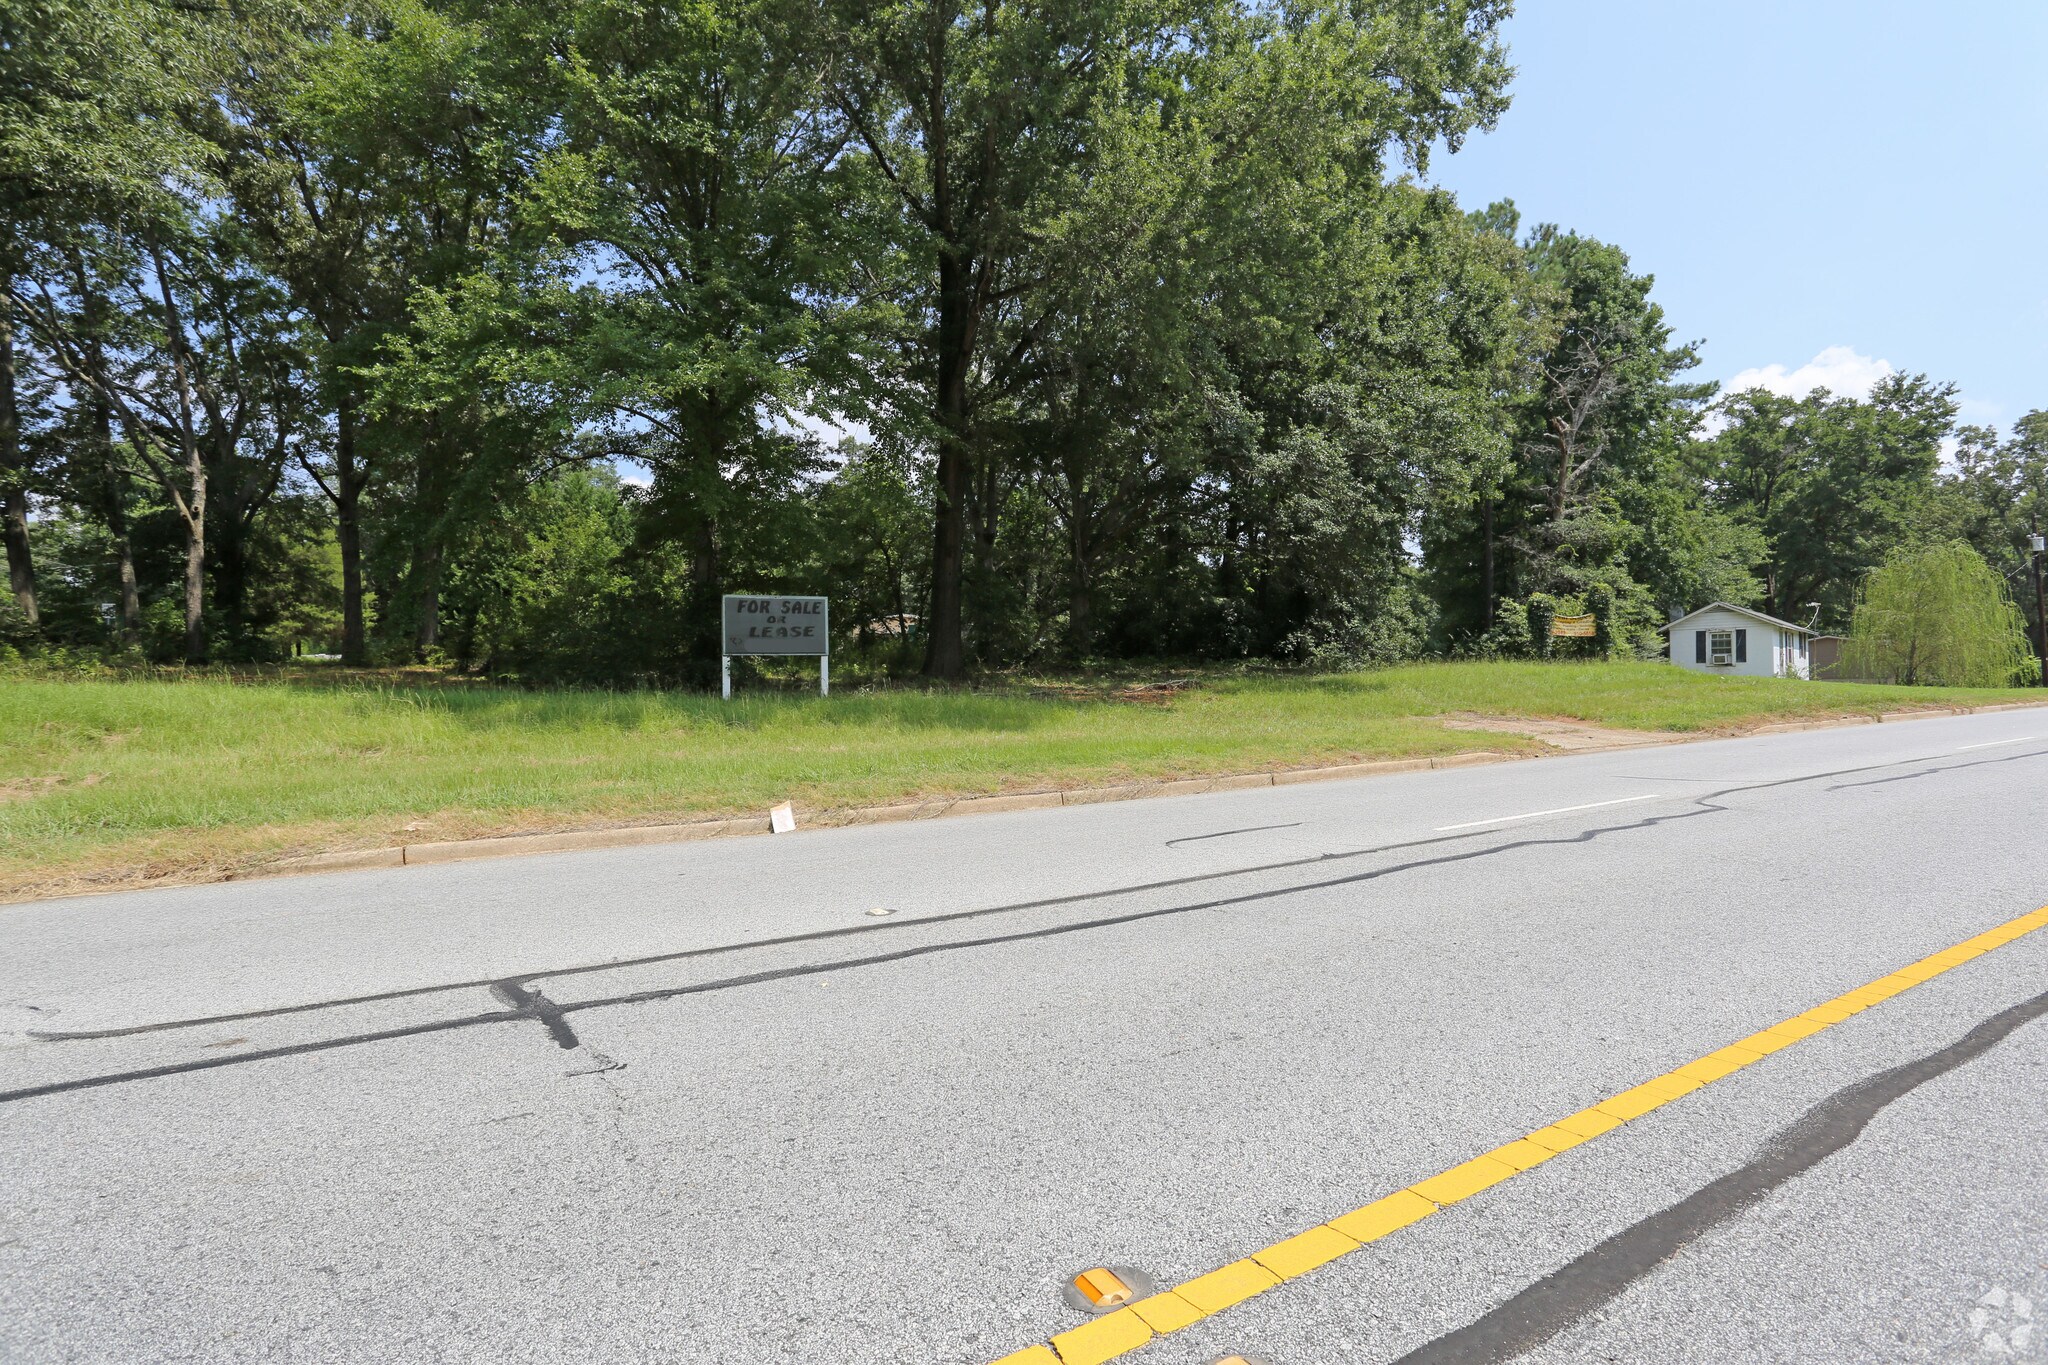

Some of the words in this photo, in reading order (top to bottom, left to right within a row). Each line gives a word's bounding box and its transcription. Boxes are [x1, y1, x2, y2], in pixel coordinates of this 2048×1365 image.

[737, 600, 770, 613] FOR
[781, 601, 821, 614] SALE
[749, 626, 815, 637] LEASE
